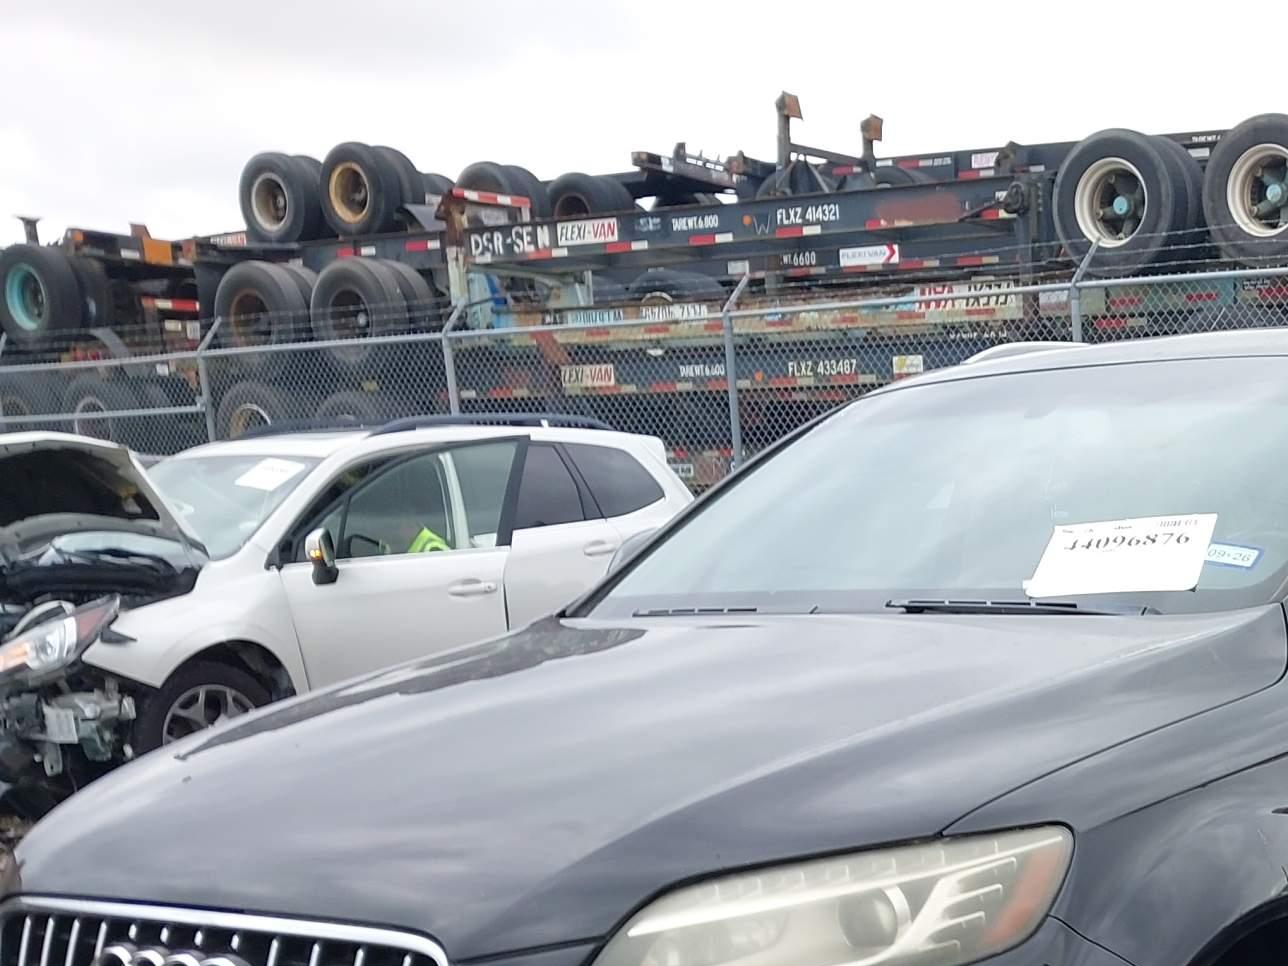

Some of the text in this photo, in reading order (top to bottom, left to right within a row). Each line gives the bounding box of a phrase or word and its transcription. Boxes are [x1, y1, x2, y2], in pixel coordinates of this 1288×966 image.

[776, 203, 840, 225] FLXZ 414321
[559, 220, 616, 243] FLEXI-VAN
[793, 251, 817, 267] 6600
[561, 366, 613, 384] LEXI-VAN
[787, 358, 857, 377] FLXZ 433487
